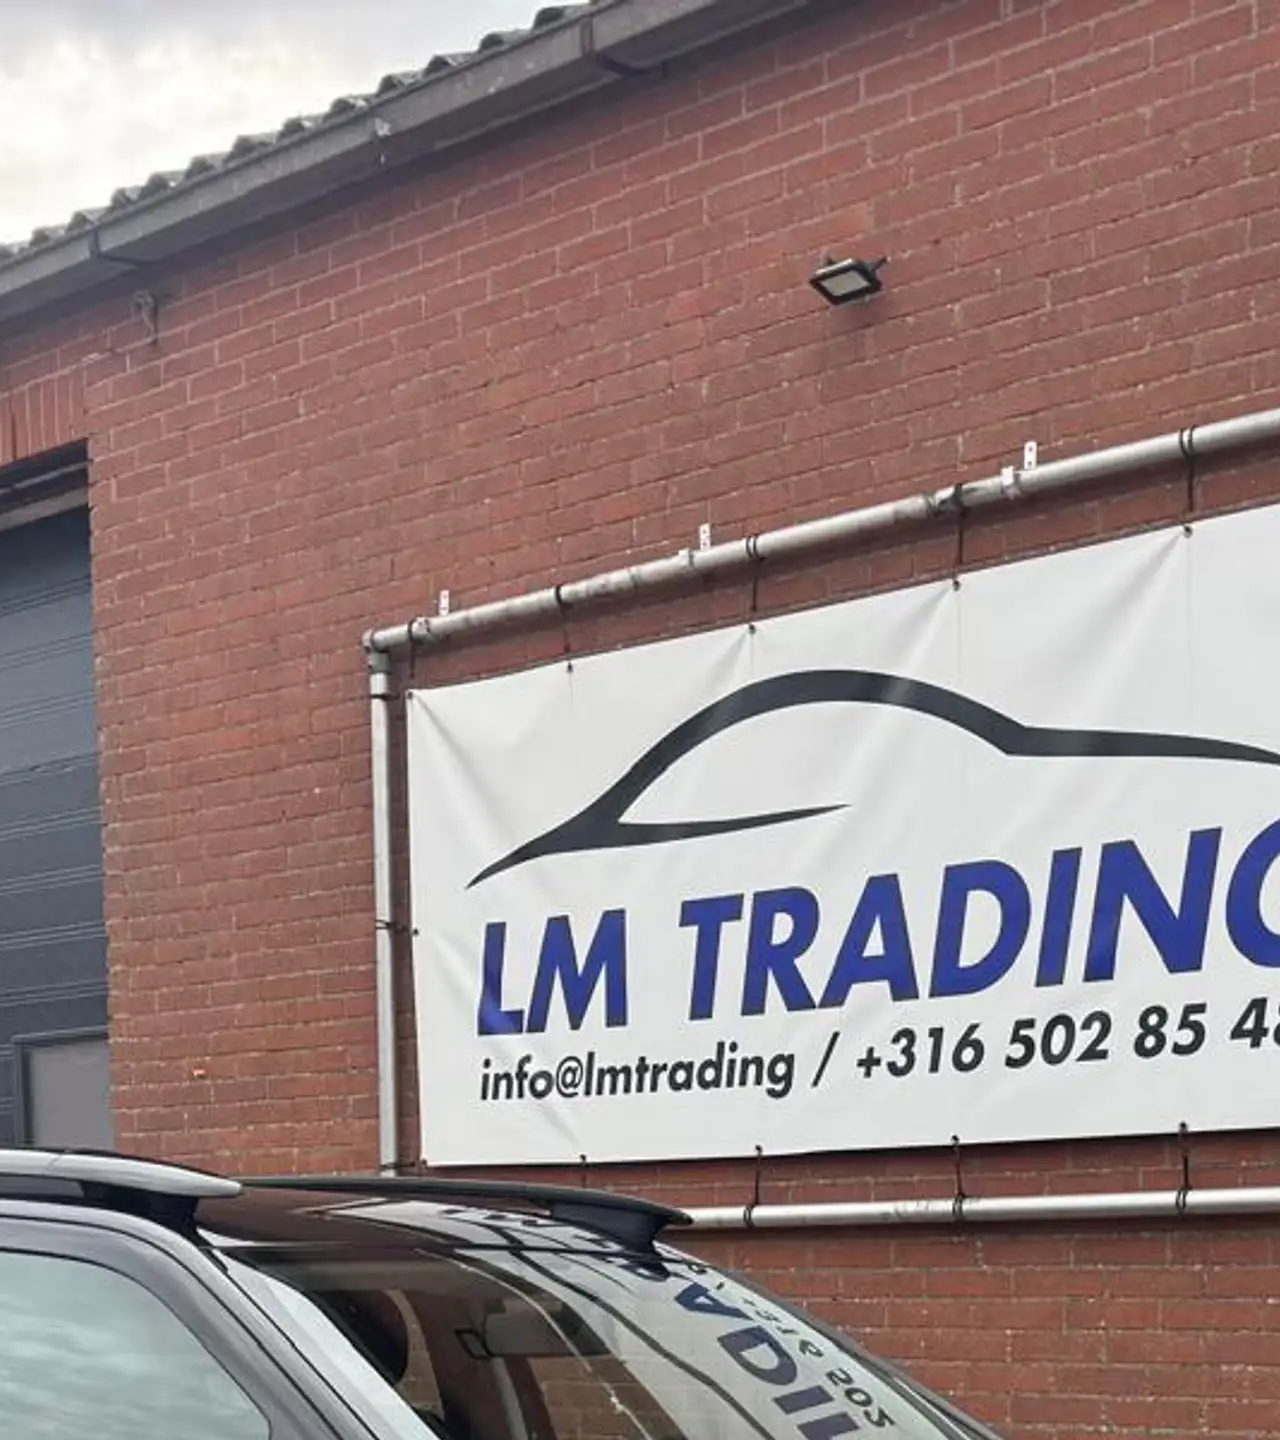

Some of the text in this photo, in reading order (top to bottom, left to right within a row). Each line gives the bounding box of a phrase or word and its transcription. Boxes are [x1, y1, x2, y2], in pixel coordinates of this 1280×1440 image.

[477, 908, 627, 1037] LM
[479, 1041, 796, 1100] info@lmtrading
[812, 1031, 840, 1087] /
[856, 1023, 986, 1079] +316
[1004, 1010, 1112, 1069] 502
[1134, 1003, 1207, 1059] 85
